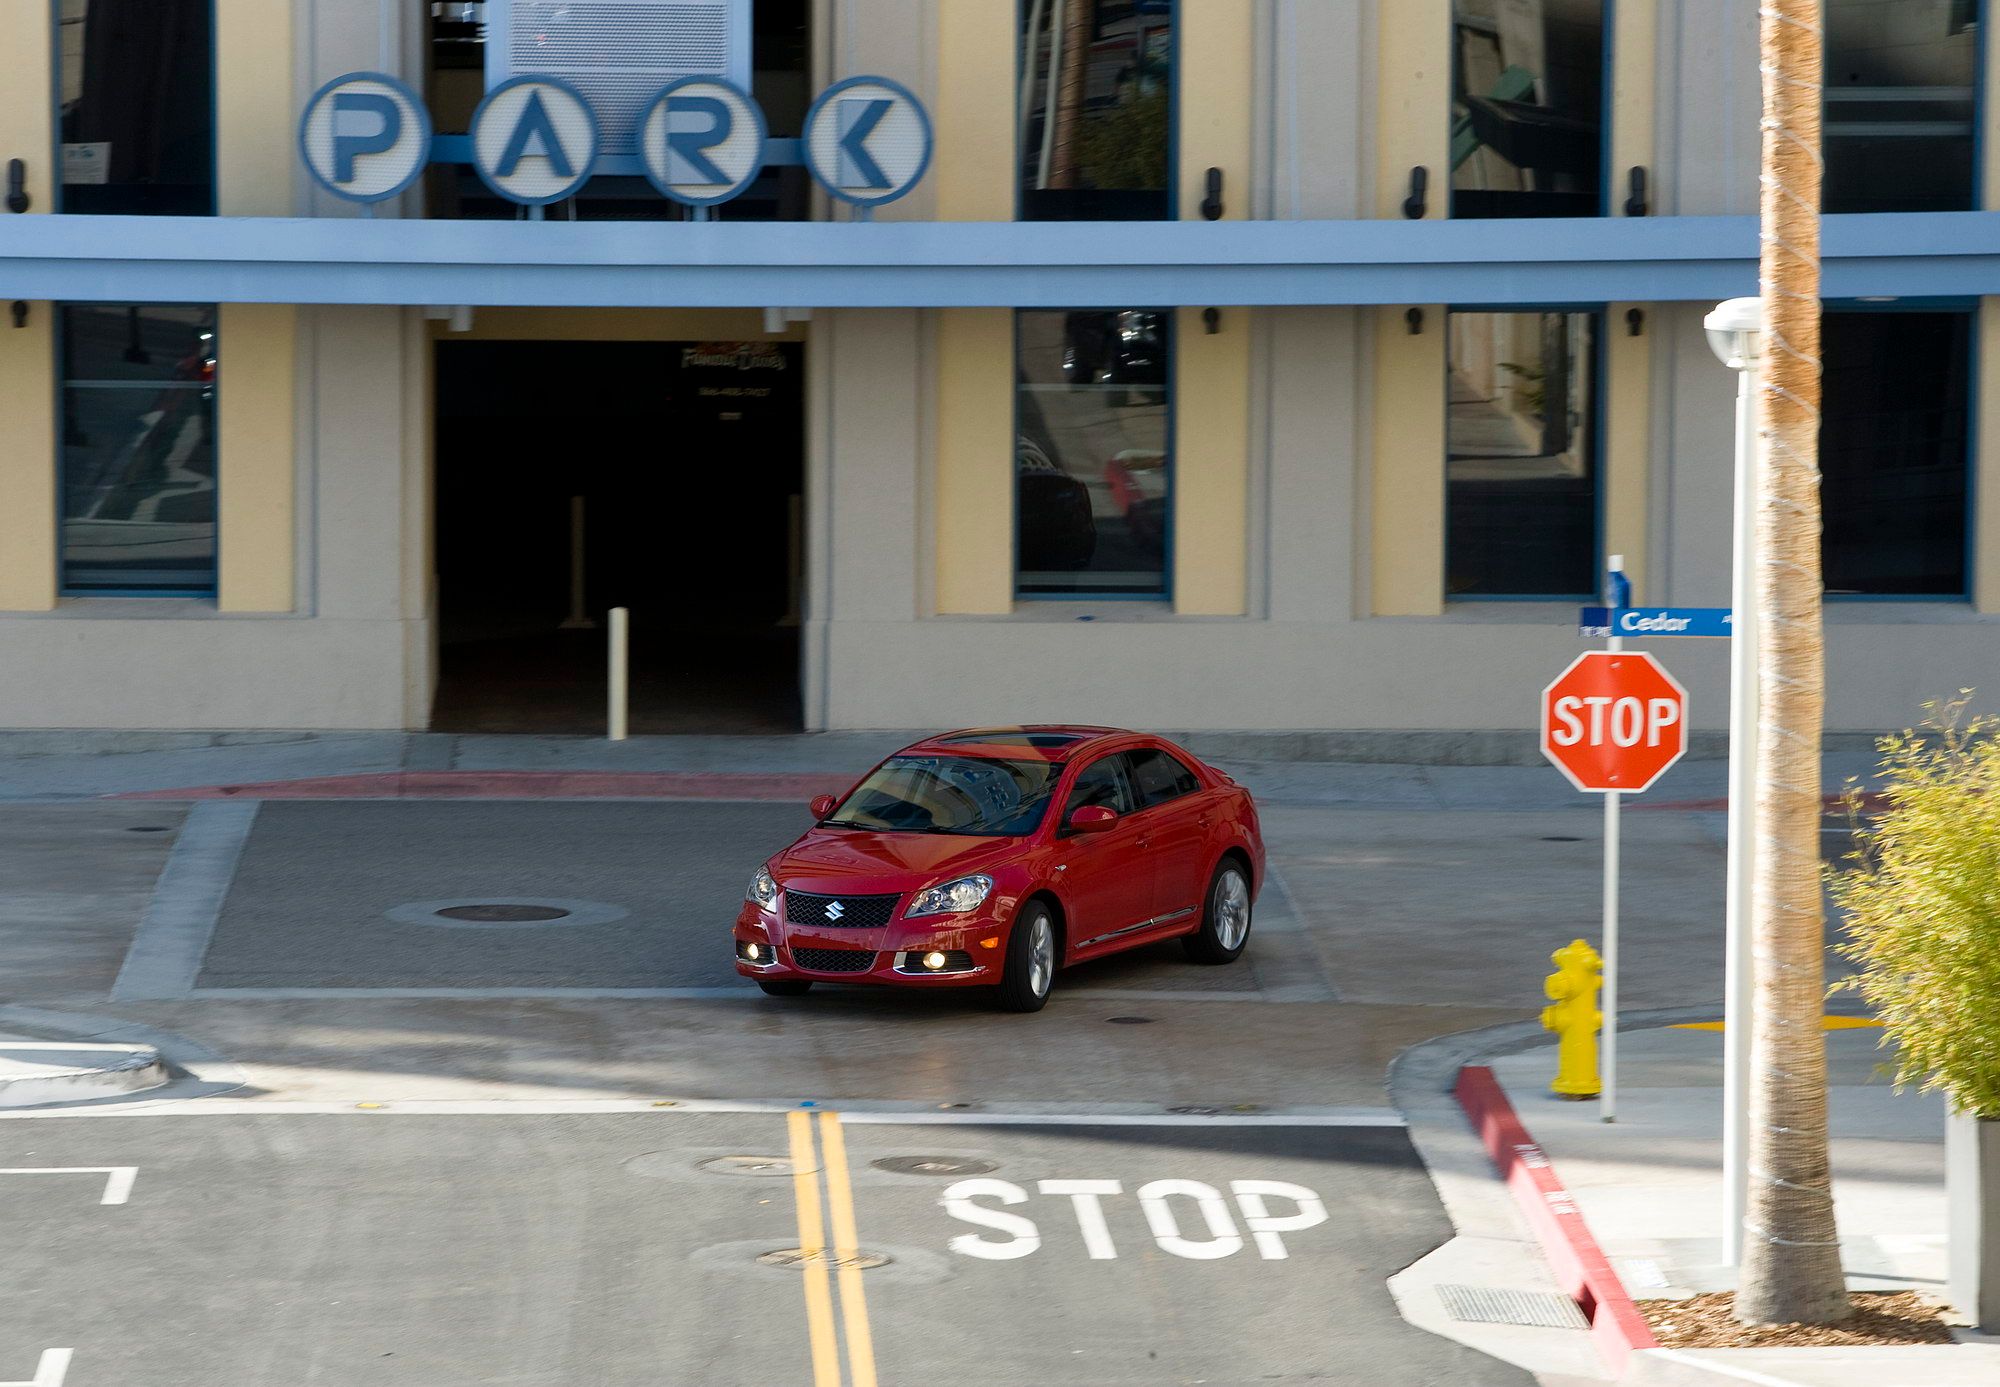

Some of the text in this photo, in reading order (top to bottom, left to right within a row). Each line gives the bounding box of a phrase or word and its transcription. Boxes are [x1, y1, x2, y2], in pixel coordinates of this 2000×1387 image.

[333, 87, 897, 189] PARK
[1620, 611, 1692, 632] Cedar
[1551, 695, 1680, 748] STOP
[940, 1178, 1330, 1260] STOP
